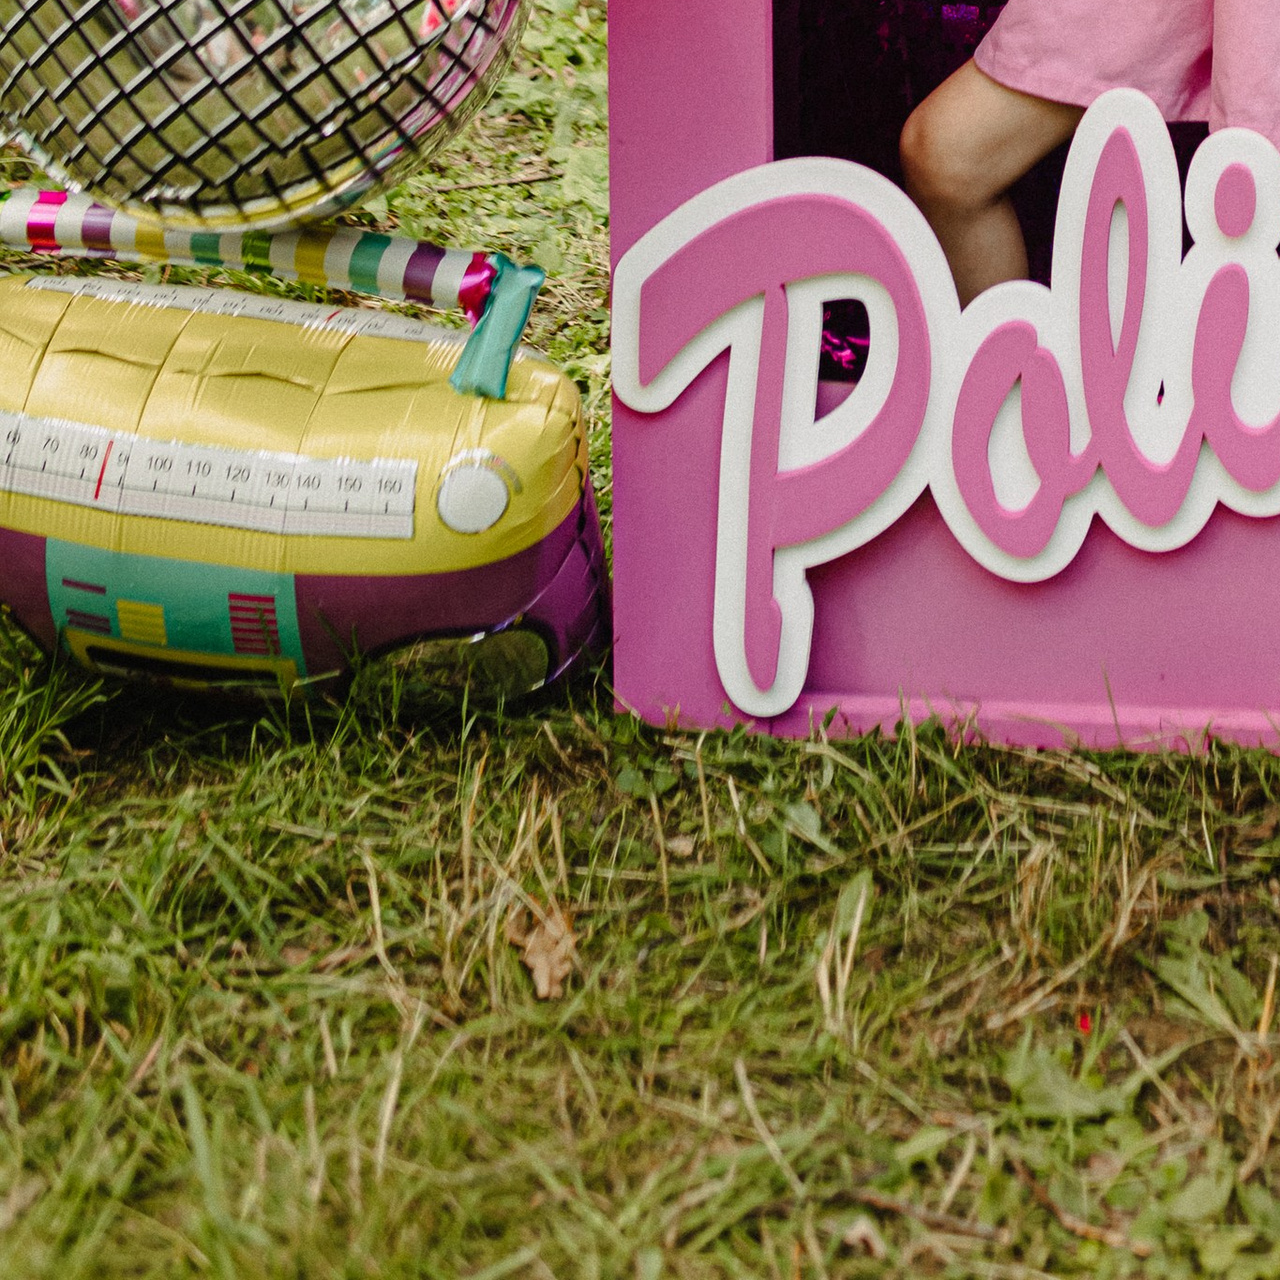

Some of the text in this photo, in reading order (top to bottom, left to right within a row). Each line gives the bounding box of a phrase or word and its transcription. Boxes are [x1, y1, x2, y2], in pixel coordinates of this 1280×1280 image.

[41, 437, 60, 454] 70
[80, 443, 98, 461] 80
[147, 455, 173, 472] 100
[186, 459, 212, 477] 110
[226, 463, 250, 483] 120
[265, 470, 290, 489] 130
[296, 474, 321, 490] 140
[337, 476, 362, 493] 150
[377, 478, 402, 494] 160
